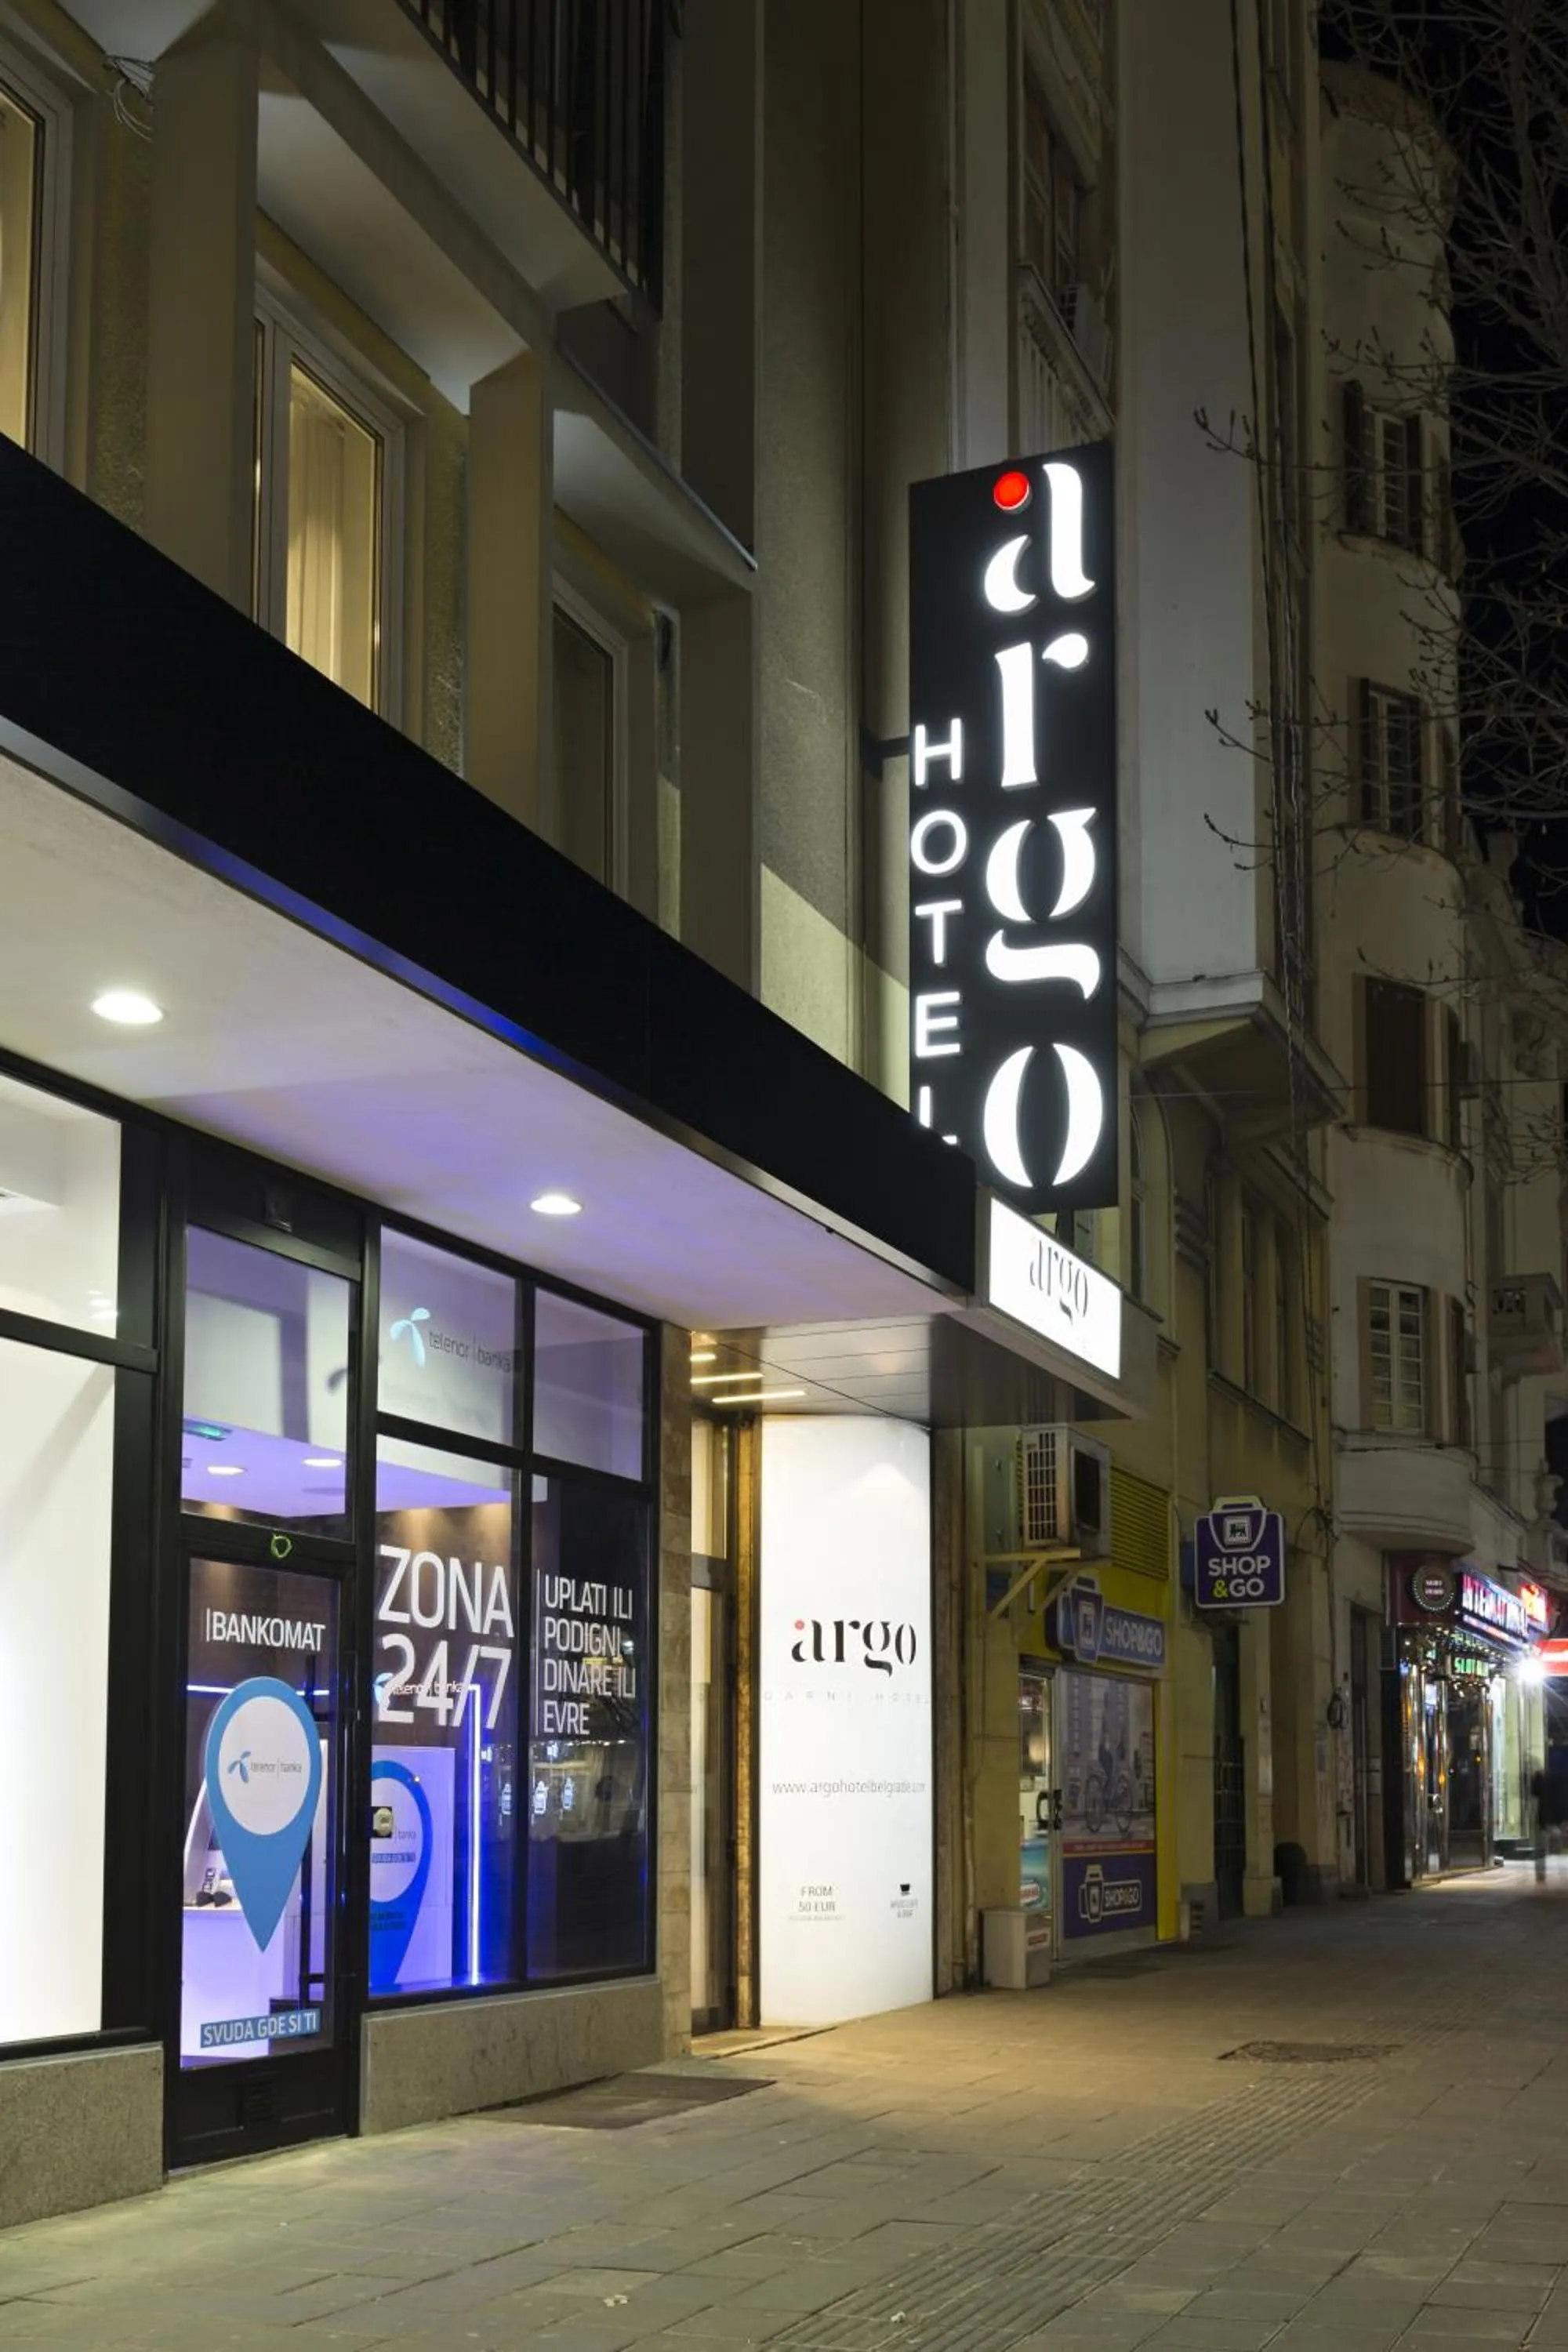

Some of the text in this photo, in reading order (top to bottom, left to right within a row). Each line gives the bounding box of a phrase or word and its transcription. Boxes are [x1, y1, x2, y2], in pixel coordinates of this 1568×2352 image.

[984, 462, 1104, 1189] argo
[1027, 1236, 1091, 1326] argo
[428, 1331, 512, 1374] telenor banka
[1208, 1555, 1271, 1577] SHOP
[377, 1544, 514, 1639] ZONA
[545, 1573, 633, 1621] UPLATI ILI
[1212, 1577, 1265, 1599] &GO
[212, 1610, 326, 1652] BANKOMAT
[544, 1616, 621, 1657] PODIGNI
[791, 1619, 916, 1677] argo
[1105, 1614, 1163, 1657] SHOP&GO
[378, 1633, 512, 1730] 24/7
[543, 1658, 636, 1698] DINARE ILI
[543, 1700, 590, 1735] EVRE
[800, 1885, 834, 1897] FROM
[203, 2012, 318, 2045] SVUDA GDE SI TI
